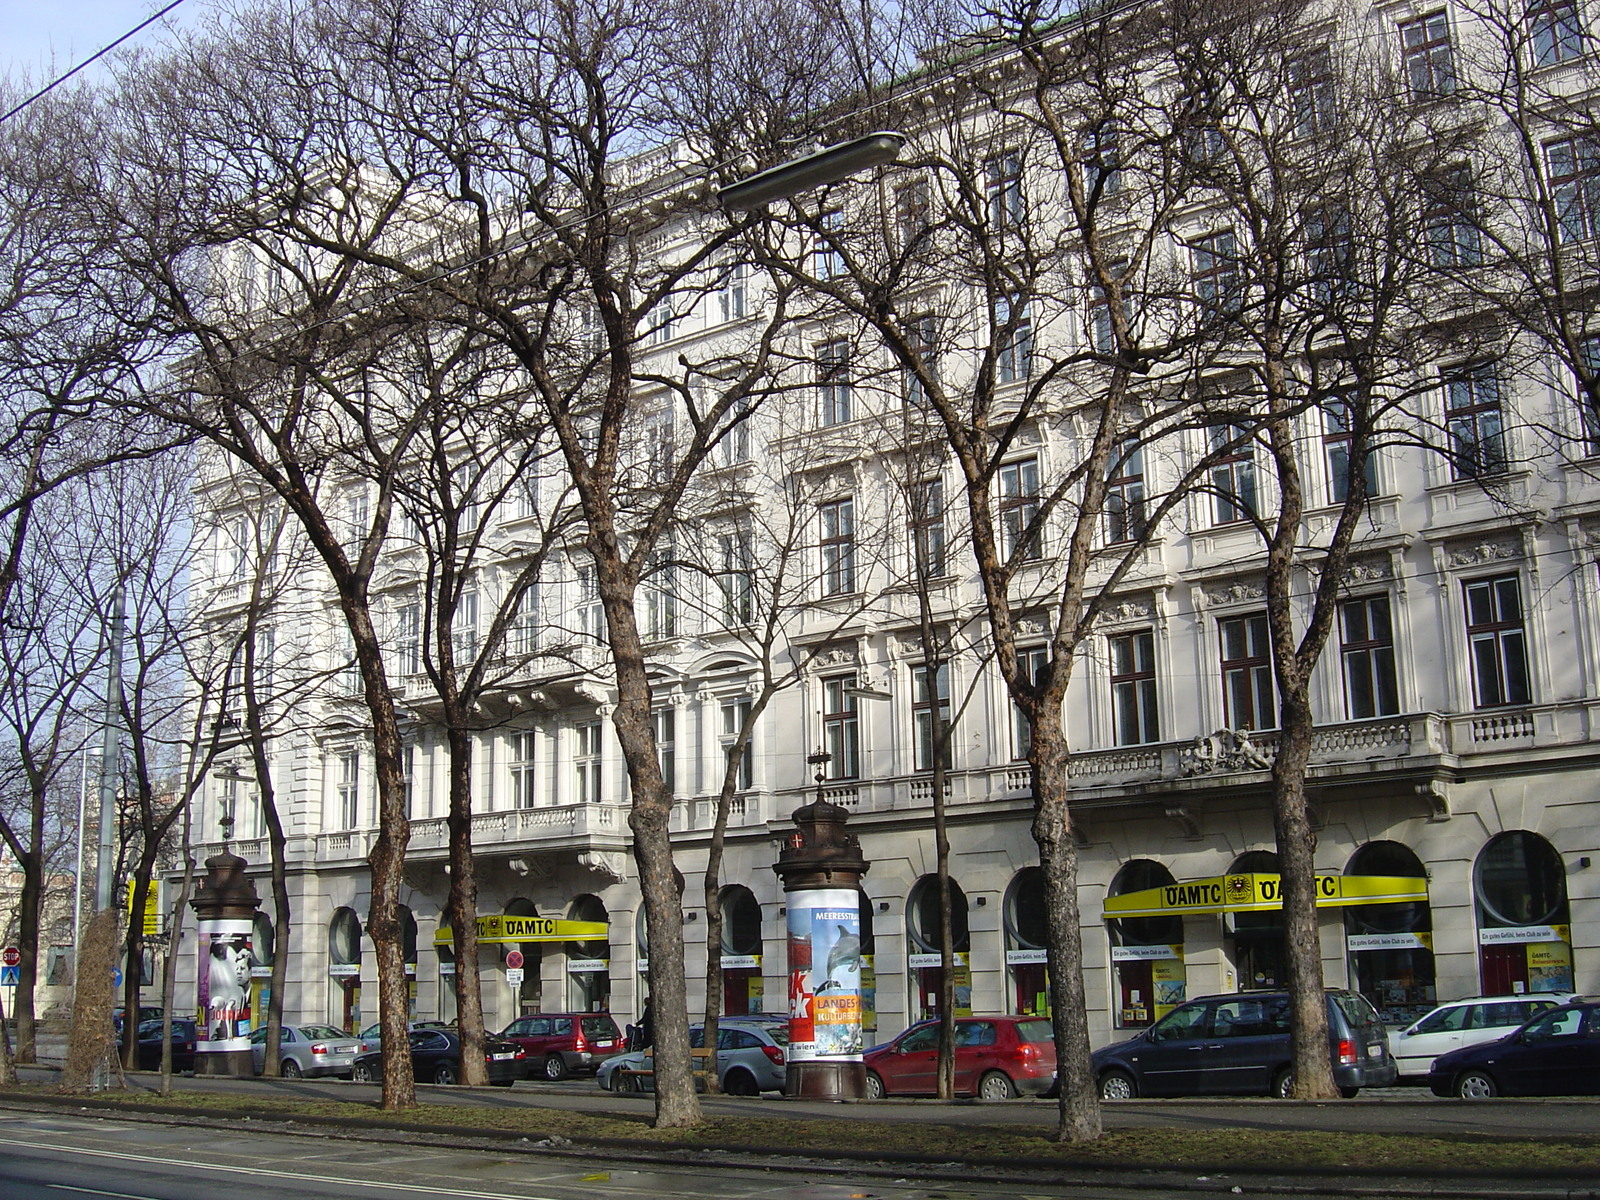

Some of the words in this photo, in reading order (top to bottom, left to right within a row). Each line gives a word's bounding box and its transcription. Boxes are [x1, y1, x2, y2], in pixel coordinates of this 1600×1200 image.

[1166, 884, 1221, 906] ÖAMTC
[506, 920, 553, 935] ÖAMTC
[4, 952, 20, 961] STOP
[817, 998, 855, 1009] LANDES
